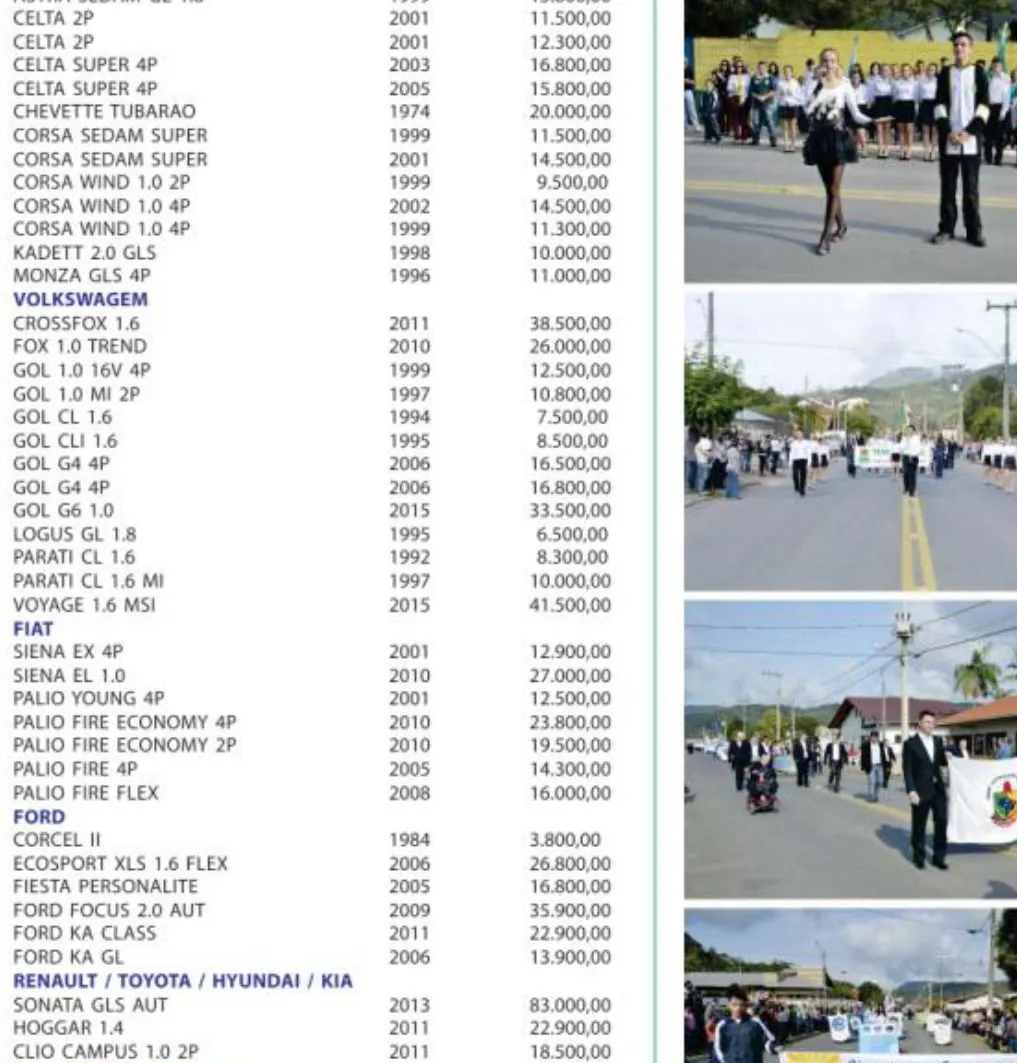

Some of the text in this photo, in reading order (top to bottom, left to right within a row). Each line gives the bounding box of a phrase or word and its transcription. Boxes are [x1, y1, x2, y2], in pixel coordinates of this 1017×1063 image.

[13, 9, 612, 28] CELTA 2P 2001 11.500,00
[12, 56, 612, 75] CELTA SUPER 4P 2003 16.800,00
[13, 103, 612, 121] CHEVETTE TUBARAO 1974 20.000,00
[13, 244, 612, 263] KADETT 2.0 GLS 1998 10.000,00
[12, 291, 149, 307] VOLKSWAGEM
[13, 315, 612, 333] CROSSFOX 1.6 2011 38.500,00
[13, 526, 609, 543] LOGUS GL 1.8 1995 6.500,00
[13, 620, 54, 637] FIAT
[13, 690, 612, 708] PALIO YOUNG 4P 2001 12.500,00
[13, 808, 66, 826] FORD
[13, 878, 612, 897] FIESTA PERSONALITE 2005 16.800,00
[13, 972, 354, 990] RENAULT TOYOTA HYUNDAI KIA
[13, 1019, 612, 1038] HOGGAR 1.4 2011 22.900,00
